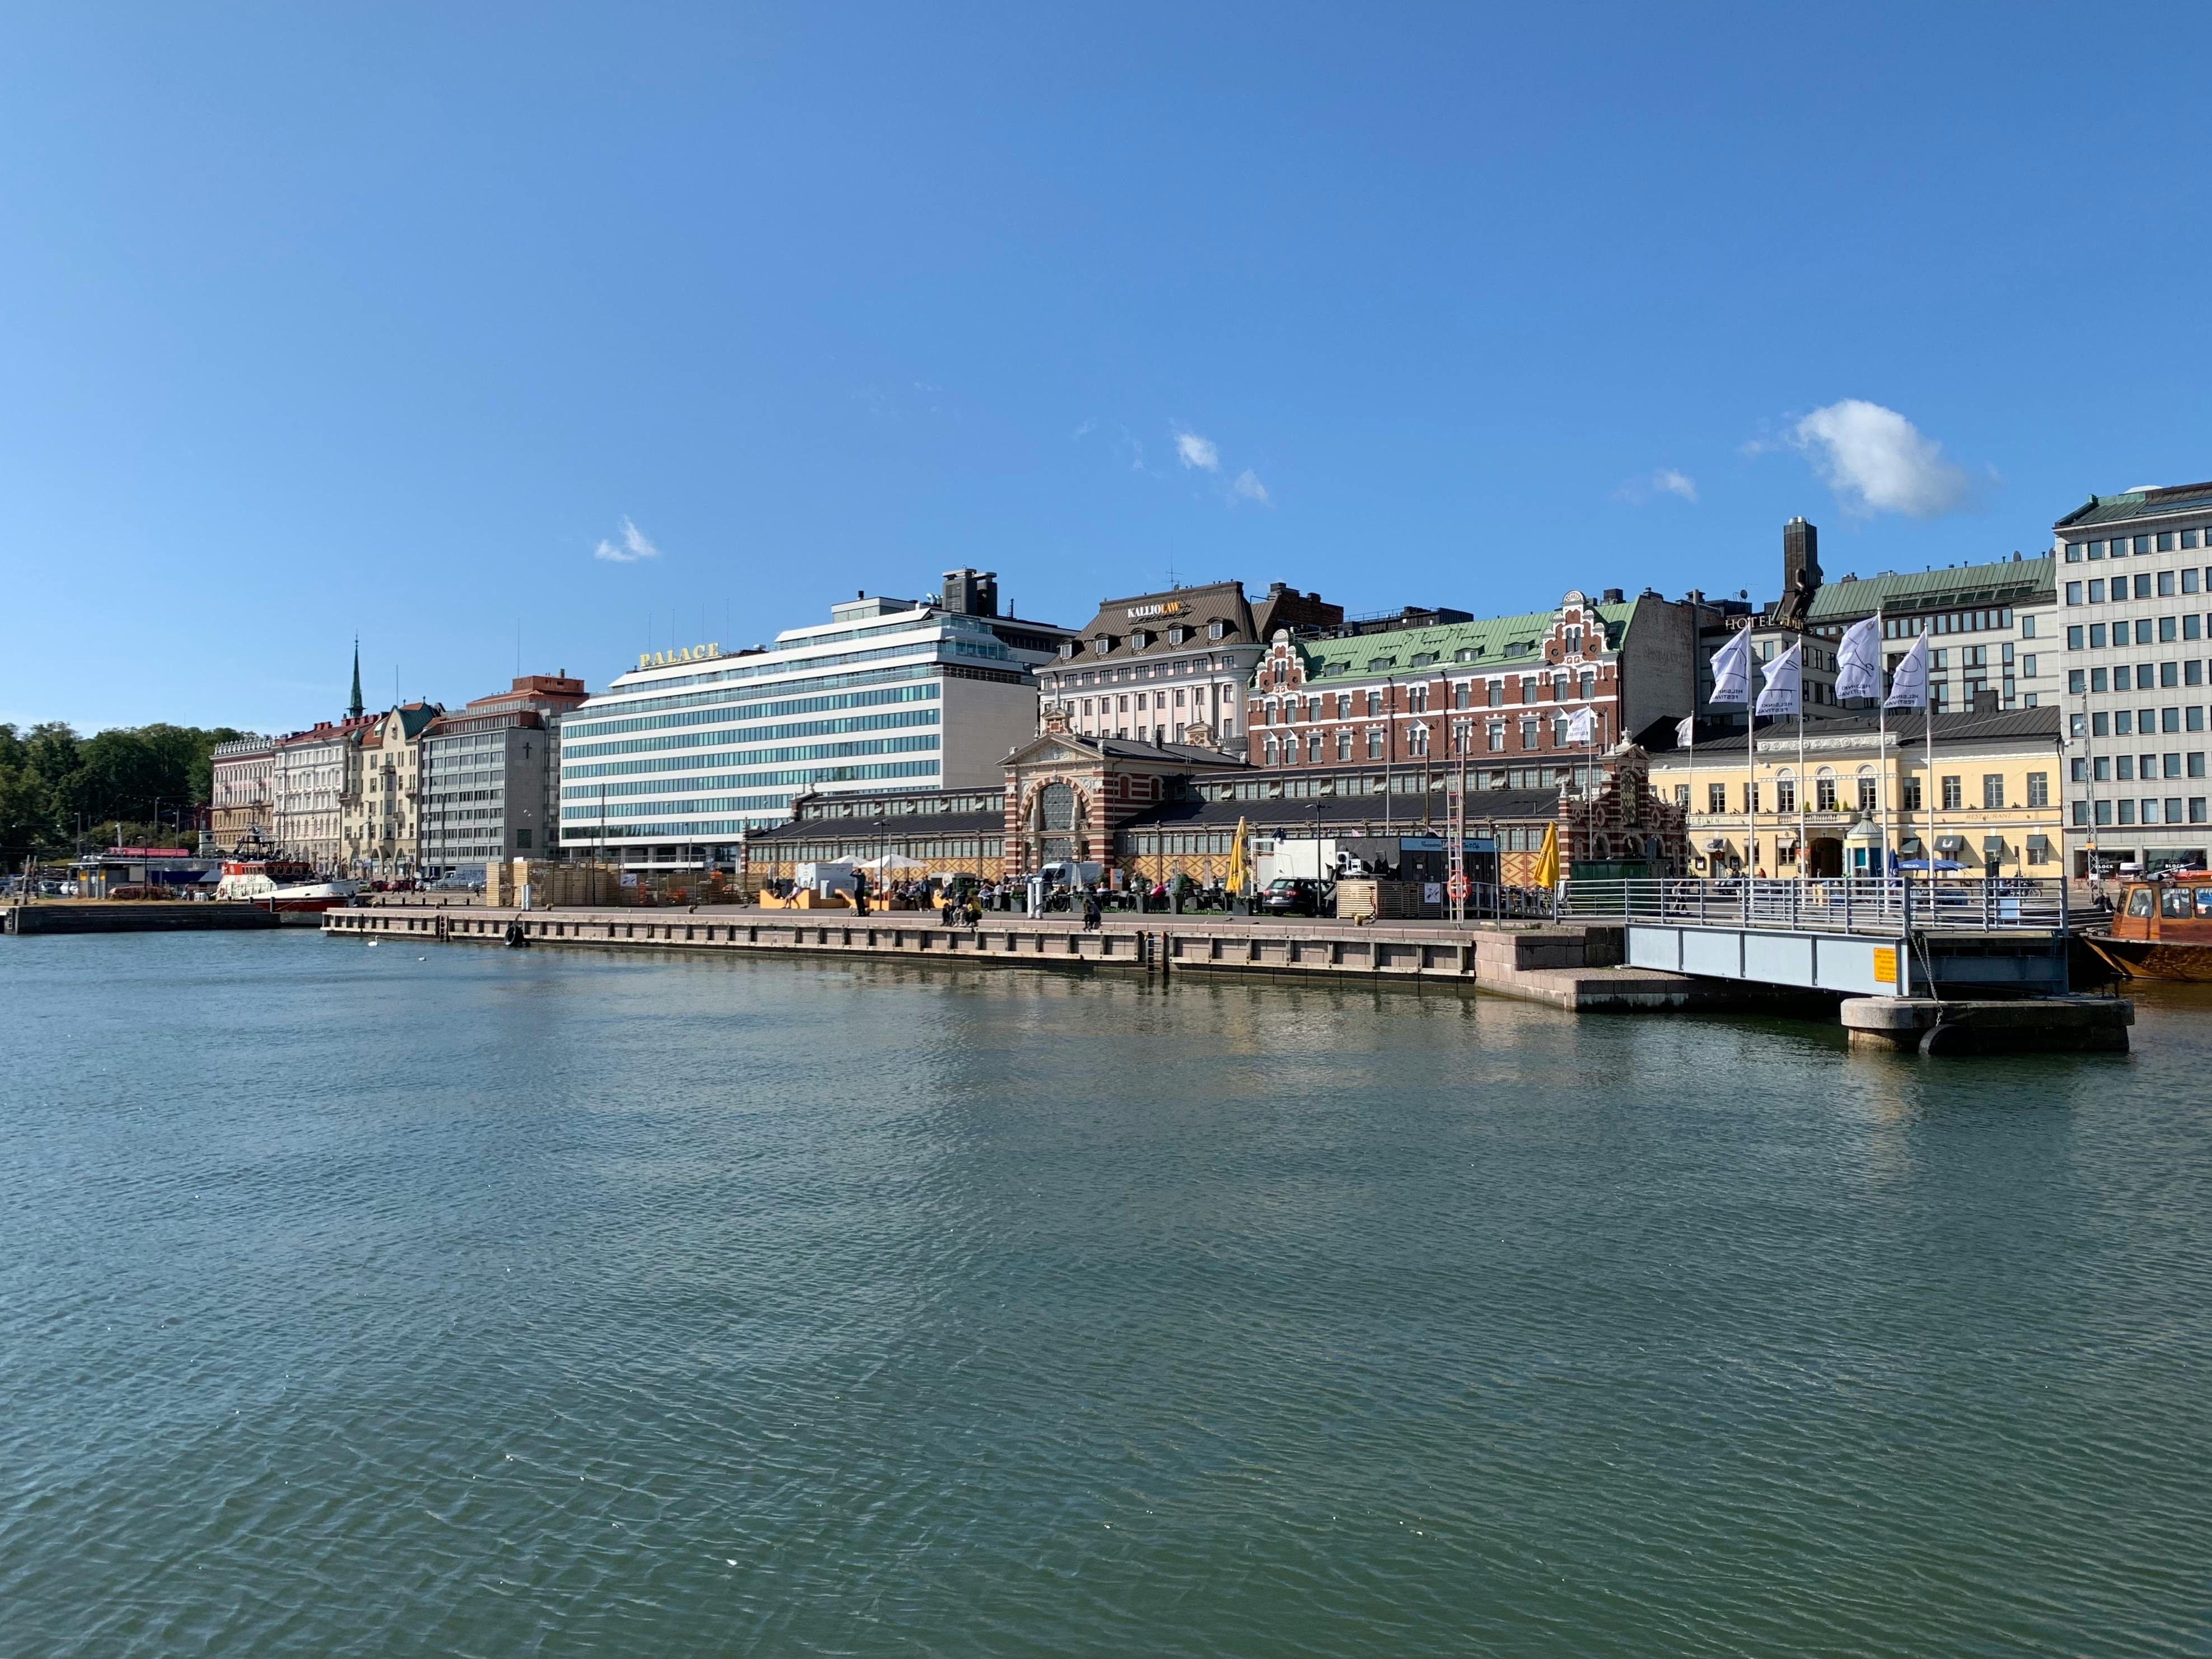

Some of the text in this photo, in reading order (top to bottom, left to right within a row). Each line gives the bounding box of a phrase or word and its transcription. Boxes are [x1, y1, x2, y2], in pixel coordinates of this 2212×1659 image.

[1128, 601, 1180, 618] KALLIOLAW
[1725, 615, 1775, 630] HOTEL
[639, 642, 719, 667] PALACE
